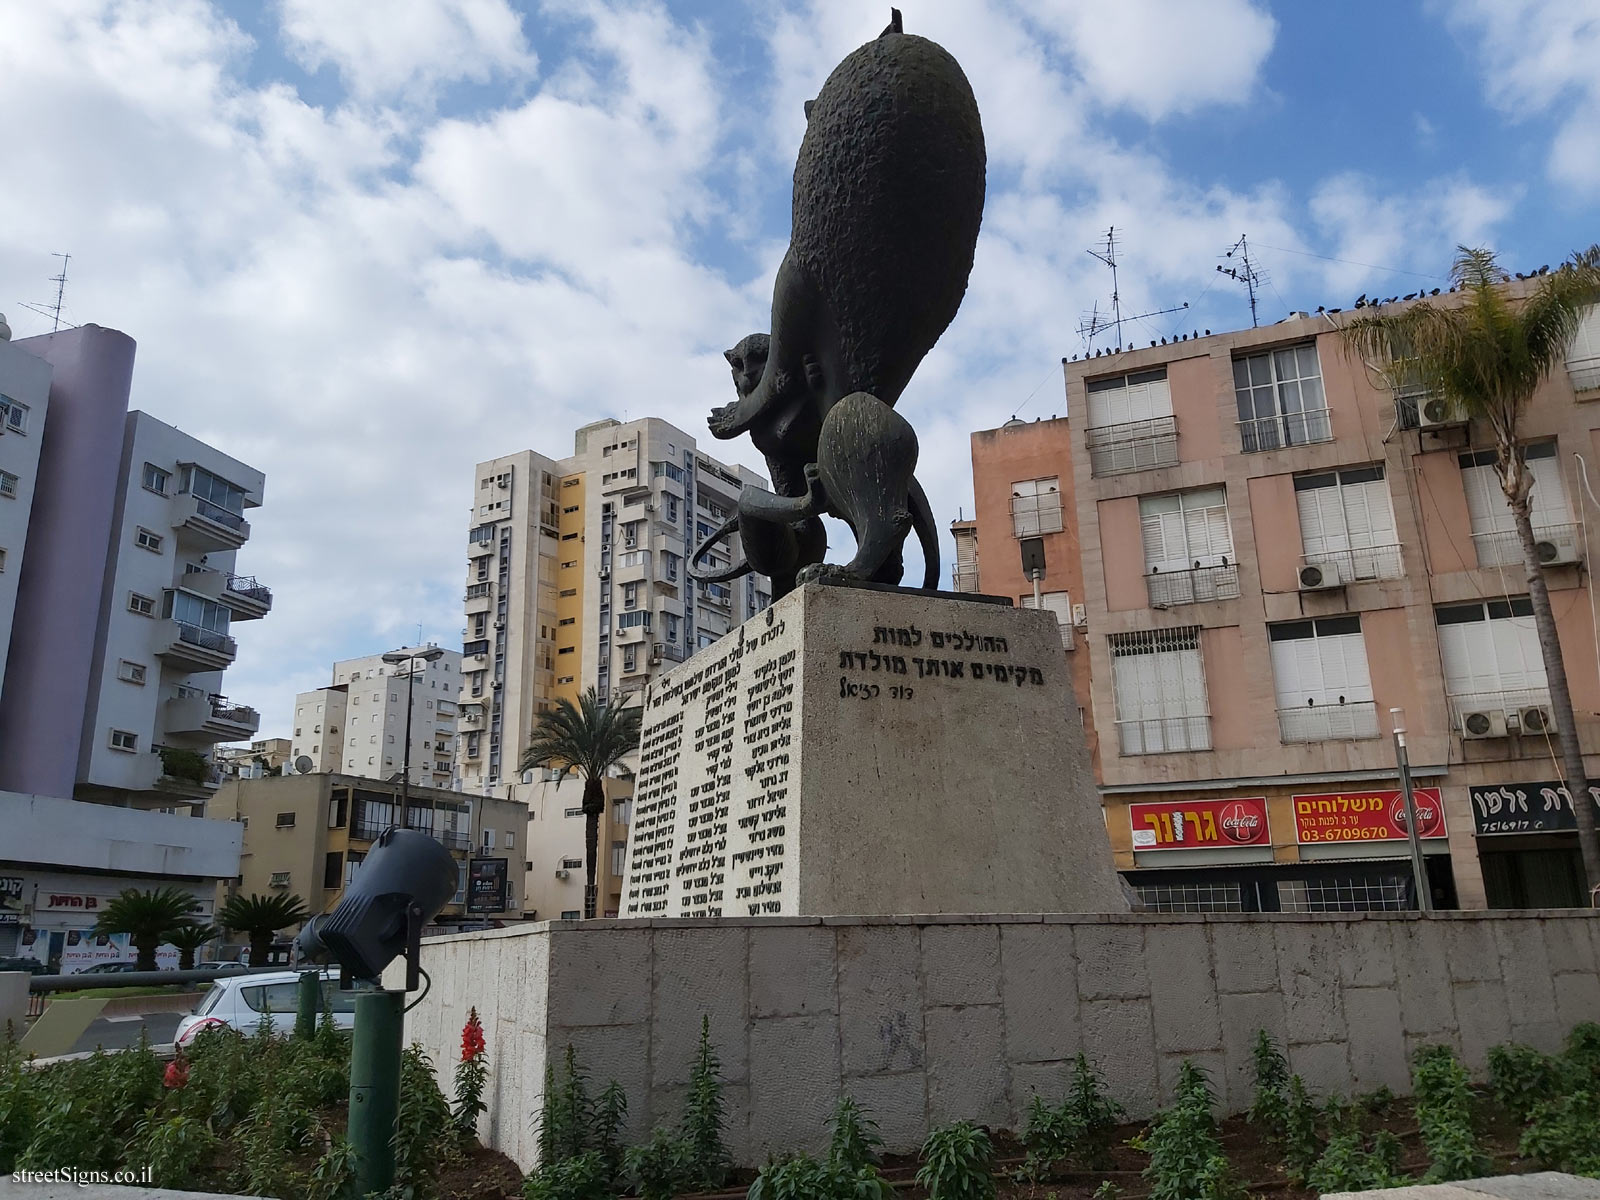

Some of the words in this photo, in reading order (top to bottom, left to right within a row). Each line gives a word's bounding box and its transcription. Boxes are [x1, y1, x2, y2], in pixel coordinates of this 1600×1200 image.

[761, 619, 784, 645] לזכרם
[872, 625, 922, 646] למות
[746, 638, 757, 653] של
[930, 630, 1008, 653] ההולכים
[779, 649, 795, 671] נעמן
[839, 650, 907, 675] מולדת
[912, 657, 964, 679] אותך
[778, 666, 794, 685] יוסף
[970, 662, 1044, 687] מקימים
[681, 686, 700, 705] ישראל
[772, 683, 792, 701] שלמה
[839, 676, 880, 700] רזיאל
[888, 686, 914, 700] דוד
[747, 698, 761, 716] יוסף
[763, 694, 769, 710] בן
[770, 701, 792, 718] מרדכי
[767, 753, 788, 769] מרדכי
[779, 770, 787, 782] דב
[767, 788, 786, 803] יחיאל
[1474, 786, 1528, 818] זלמן
[762, 804, 785, 821] אליעזר
[1297, 796, 1383, 815] משלוחים
[1223, 815, 1258, 829] Coca-Cola
[1300, 817, 1317, 828] בוקר
[1319, 815, 1339, 826] לפנות
[1341, 816, 1347, 825] 3
[767, 825, 784, 838] משה
[1301, 827, 1388, 841] 03-6709670
[766, 844, 783, 855] מאיר
[764, 862, 782, 880] יעקב
[753, 880, 781, 896] אבשלום
[762, 901, 780, 912] מאיר
